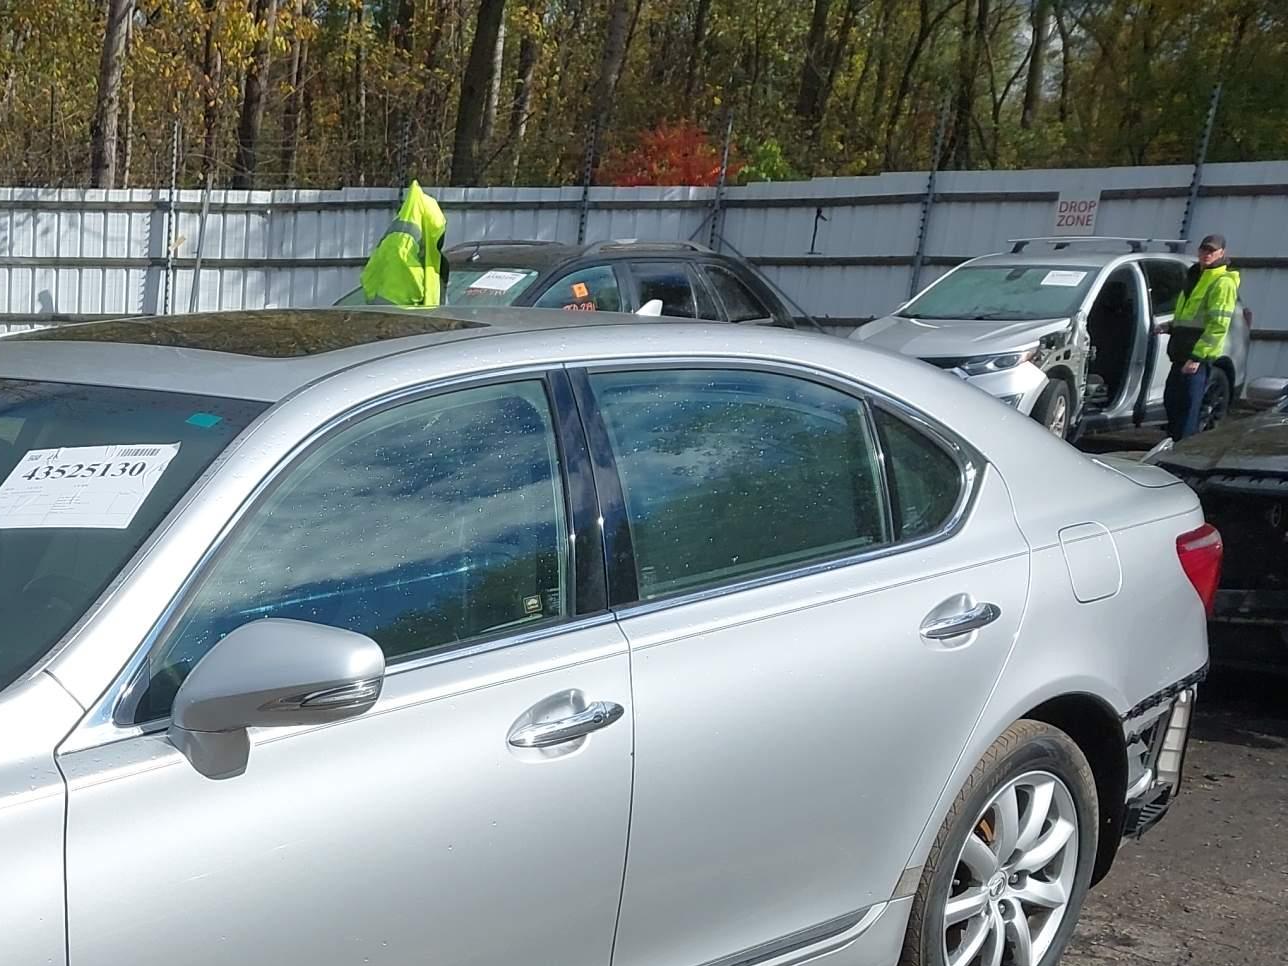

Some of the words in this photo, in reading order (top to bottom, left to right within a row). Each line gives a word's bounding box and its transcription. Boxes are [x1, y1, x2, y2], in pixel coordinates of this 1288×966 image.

[1058, 200, 1097, 213] DROP
[1056, 214, 1094, 227] ZONE
[22, 461, 147, 481] 43525130
